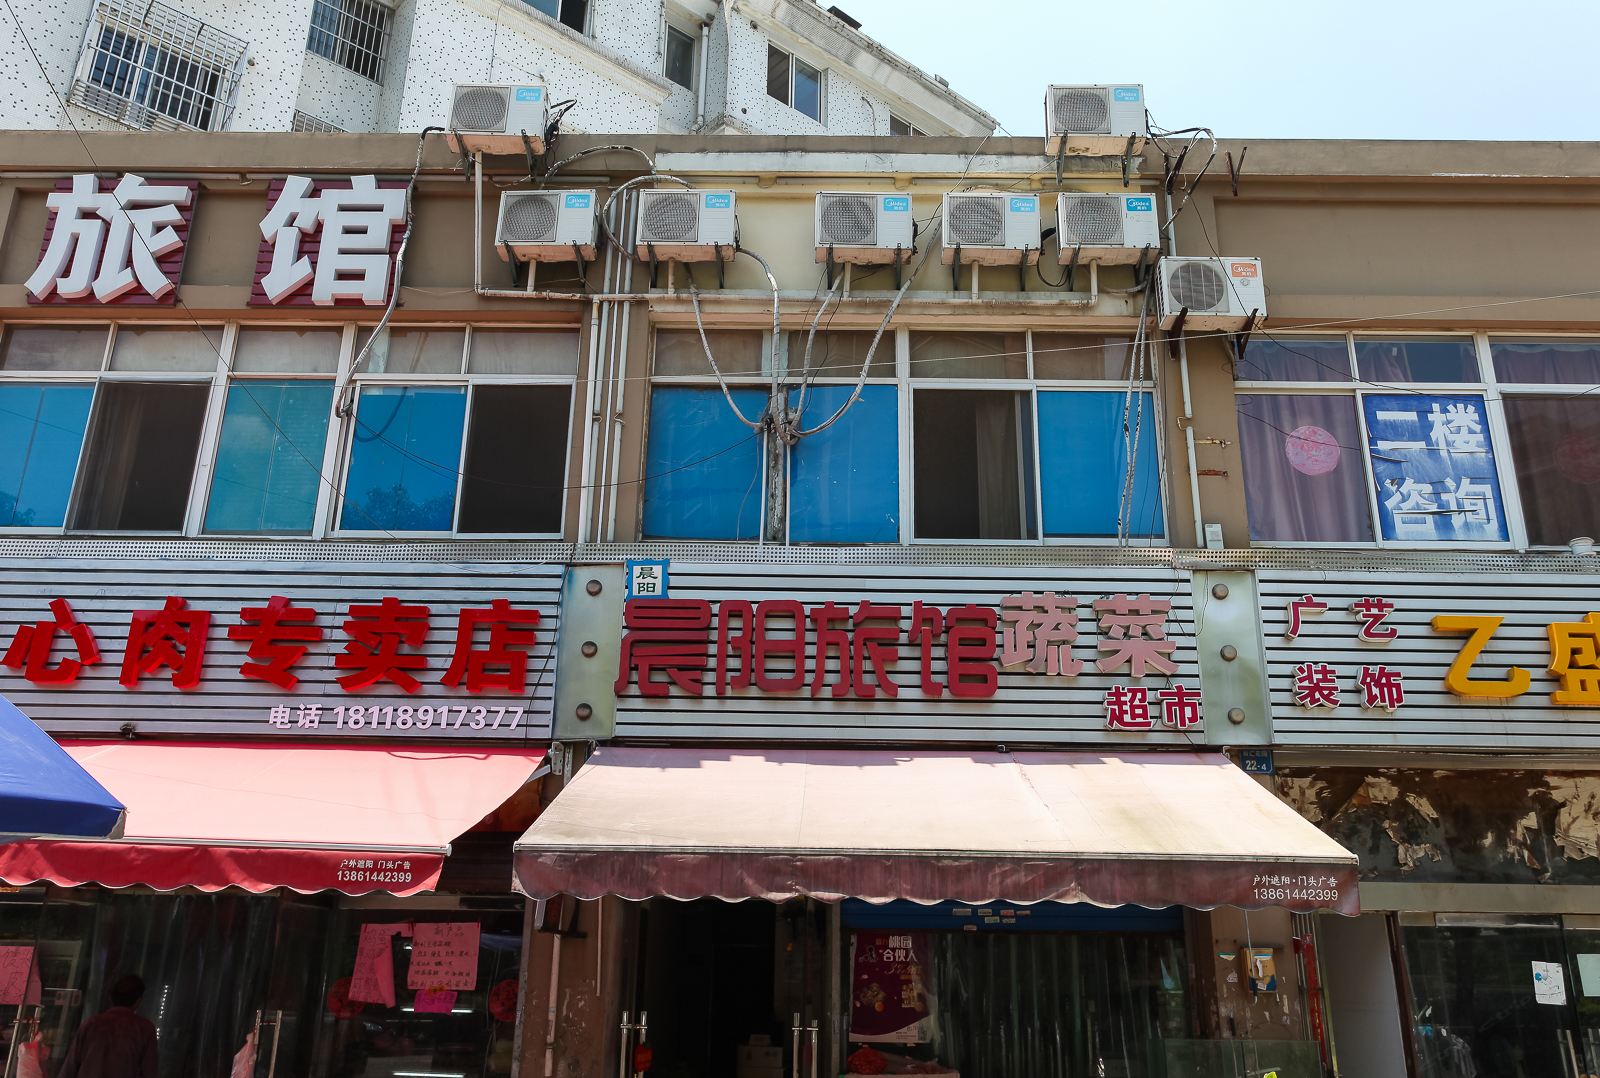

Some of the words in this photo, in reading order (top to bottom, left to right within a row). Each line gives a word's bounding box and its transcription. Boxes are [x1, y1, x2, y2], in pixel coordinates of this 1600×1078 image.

[1128, 199, 1149, 207] Midea
[24, 173, 407, 305] 旅馆
[1233, 264, 1254, 272] Midea
[1376, 403, 1486, 457] 二楼
[1384, 476, 1496, 538] 咨询
[635, 567, 658, 594] 晨阳
[1285, 594, 1398, 643] 广艺
[1, 596, 541, 693] 心肉专卖店
[614, 598, 998, 698] 晨阳旅馆
[999, 591, 1180, 678] 蔬菜
[1292, 662, 1406, 713] 装饰
[268, 703, 323, 730] 电话
[332, 704, 525, 731] 18118917377
[1104, 684, 1202, 731] 超市
[1245, 759, 1267, 771] 22-4
[337, 870, 412, 883] 13861442399
[340, 859, 374, 869] 户外遮阳
[377, 860, 411, 870] 门头广告
[1253, 888, 1339, 901] 13861442399
[883, 949, 919, 963] 合伙人
